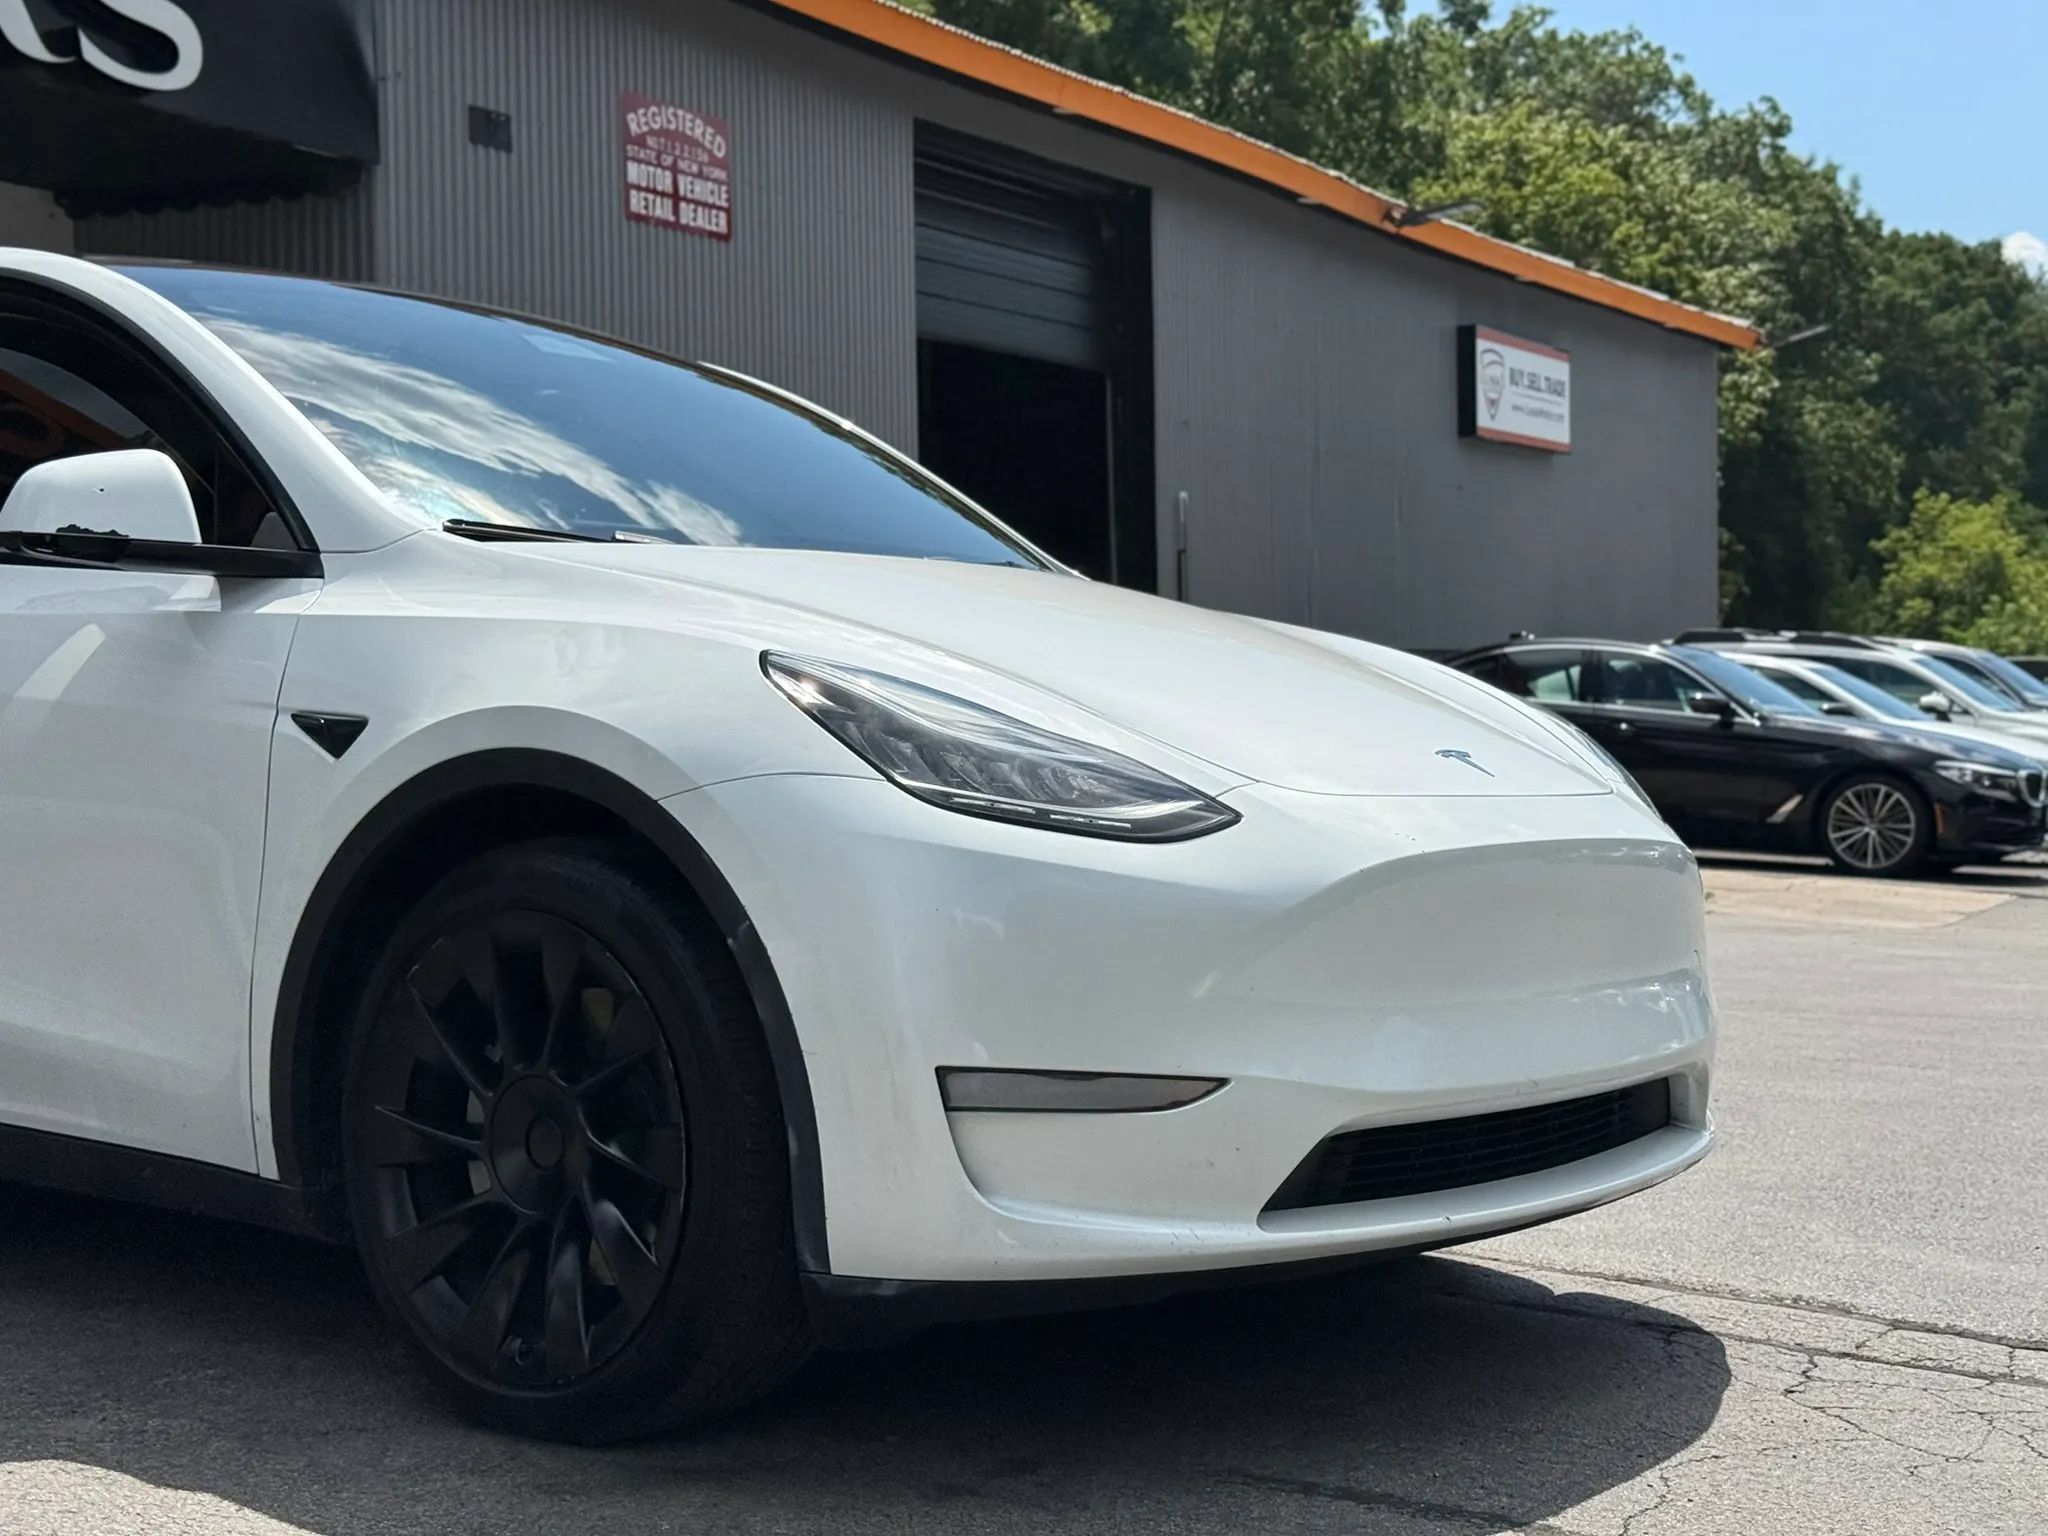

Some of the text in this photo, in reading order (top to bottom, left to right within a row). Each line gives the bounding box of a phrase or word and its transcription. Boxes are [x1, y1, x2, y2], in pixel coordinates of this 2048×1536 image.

[626, 106, 726, 158] REGISTERED
[626, 144, 728, 181] STATE OF NEW YORK
[626, 160, 729, 208] MOTOR VEHICLE
[629, 189, 729, 234] RETAIL DEALER
